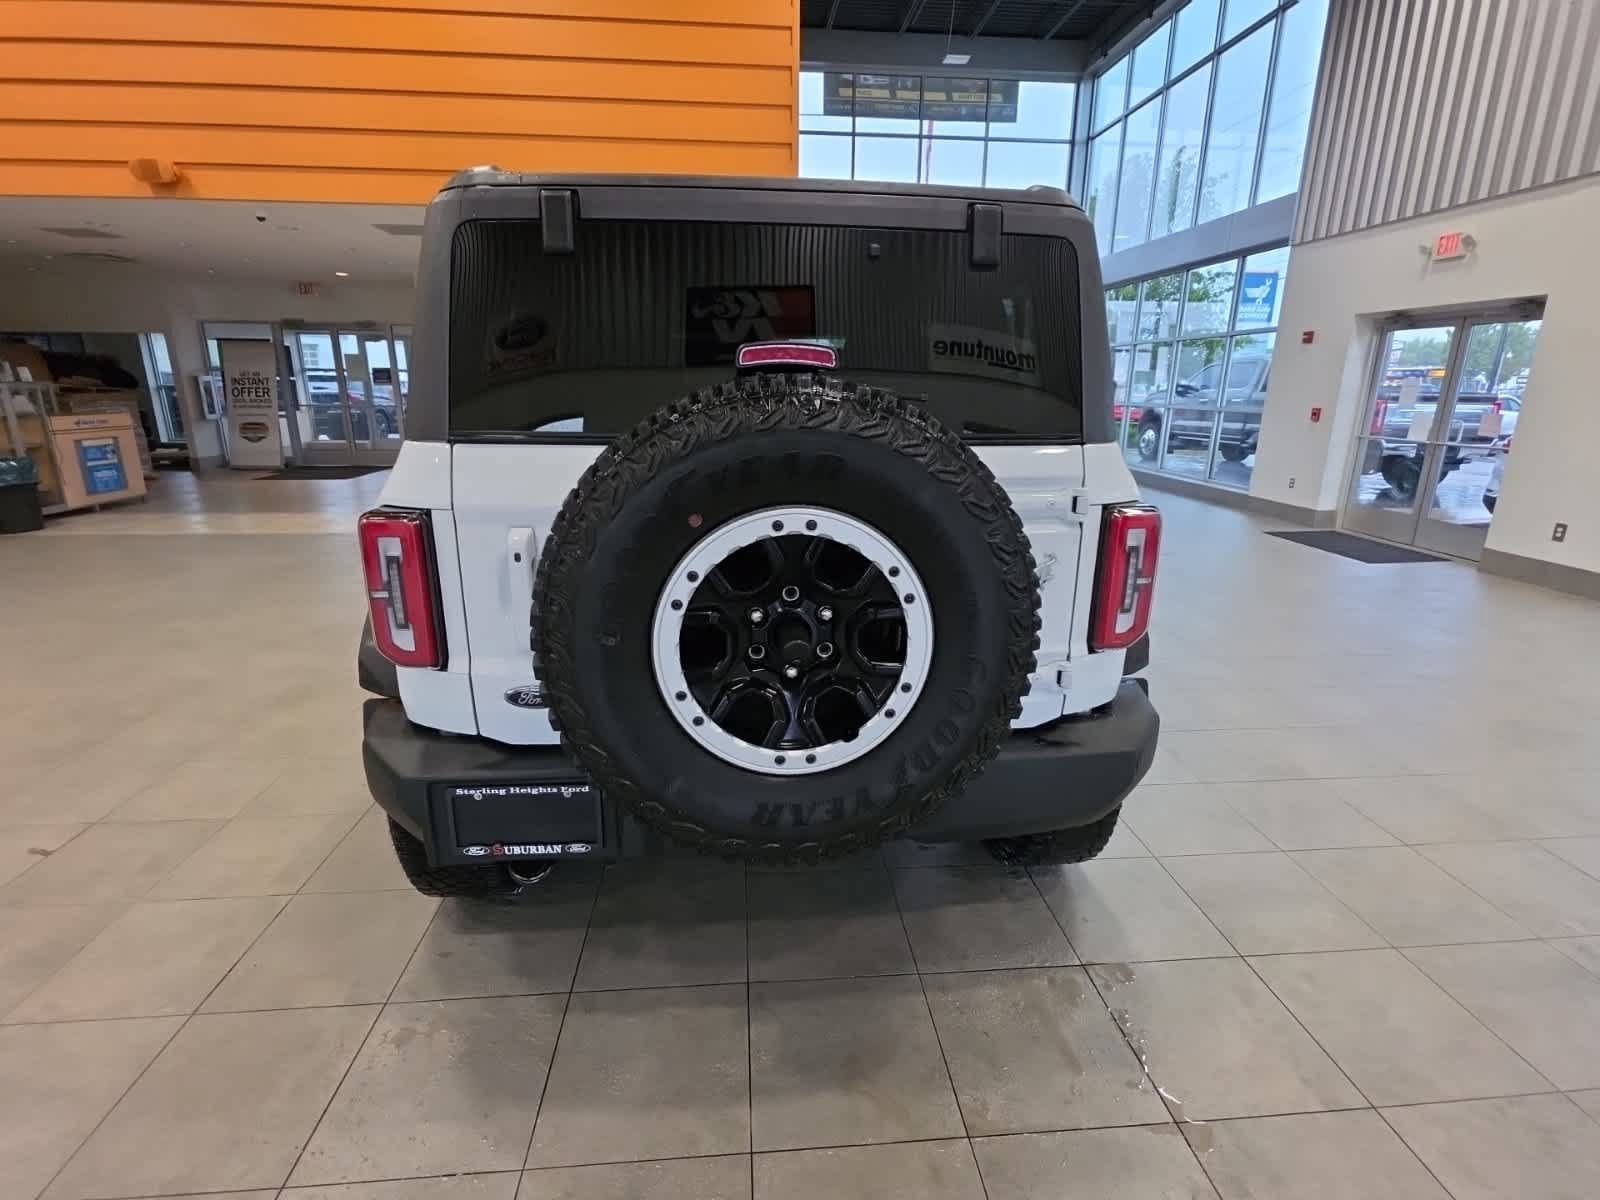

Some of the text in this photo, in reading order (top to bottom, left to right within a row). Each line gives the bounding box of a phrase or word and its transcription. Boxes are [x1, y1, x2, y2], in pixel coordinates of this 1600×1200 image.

[1437, 233, 1460, 256] EXIT
[230, 376, 270, 386] INSTANT
[231, 386, 271, 398] OFFER
[455, 784, 590, 796] Sterling Heights Ford
[492, 843, 562, 856] SUBURBAN
